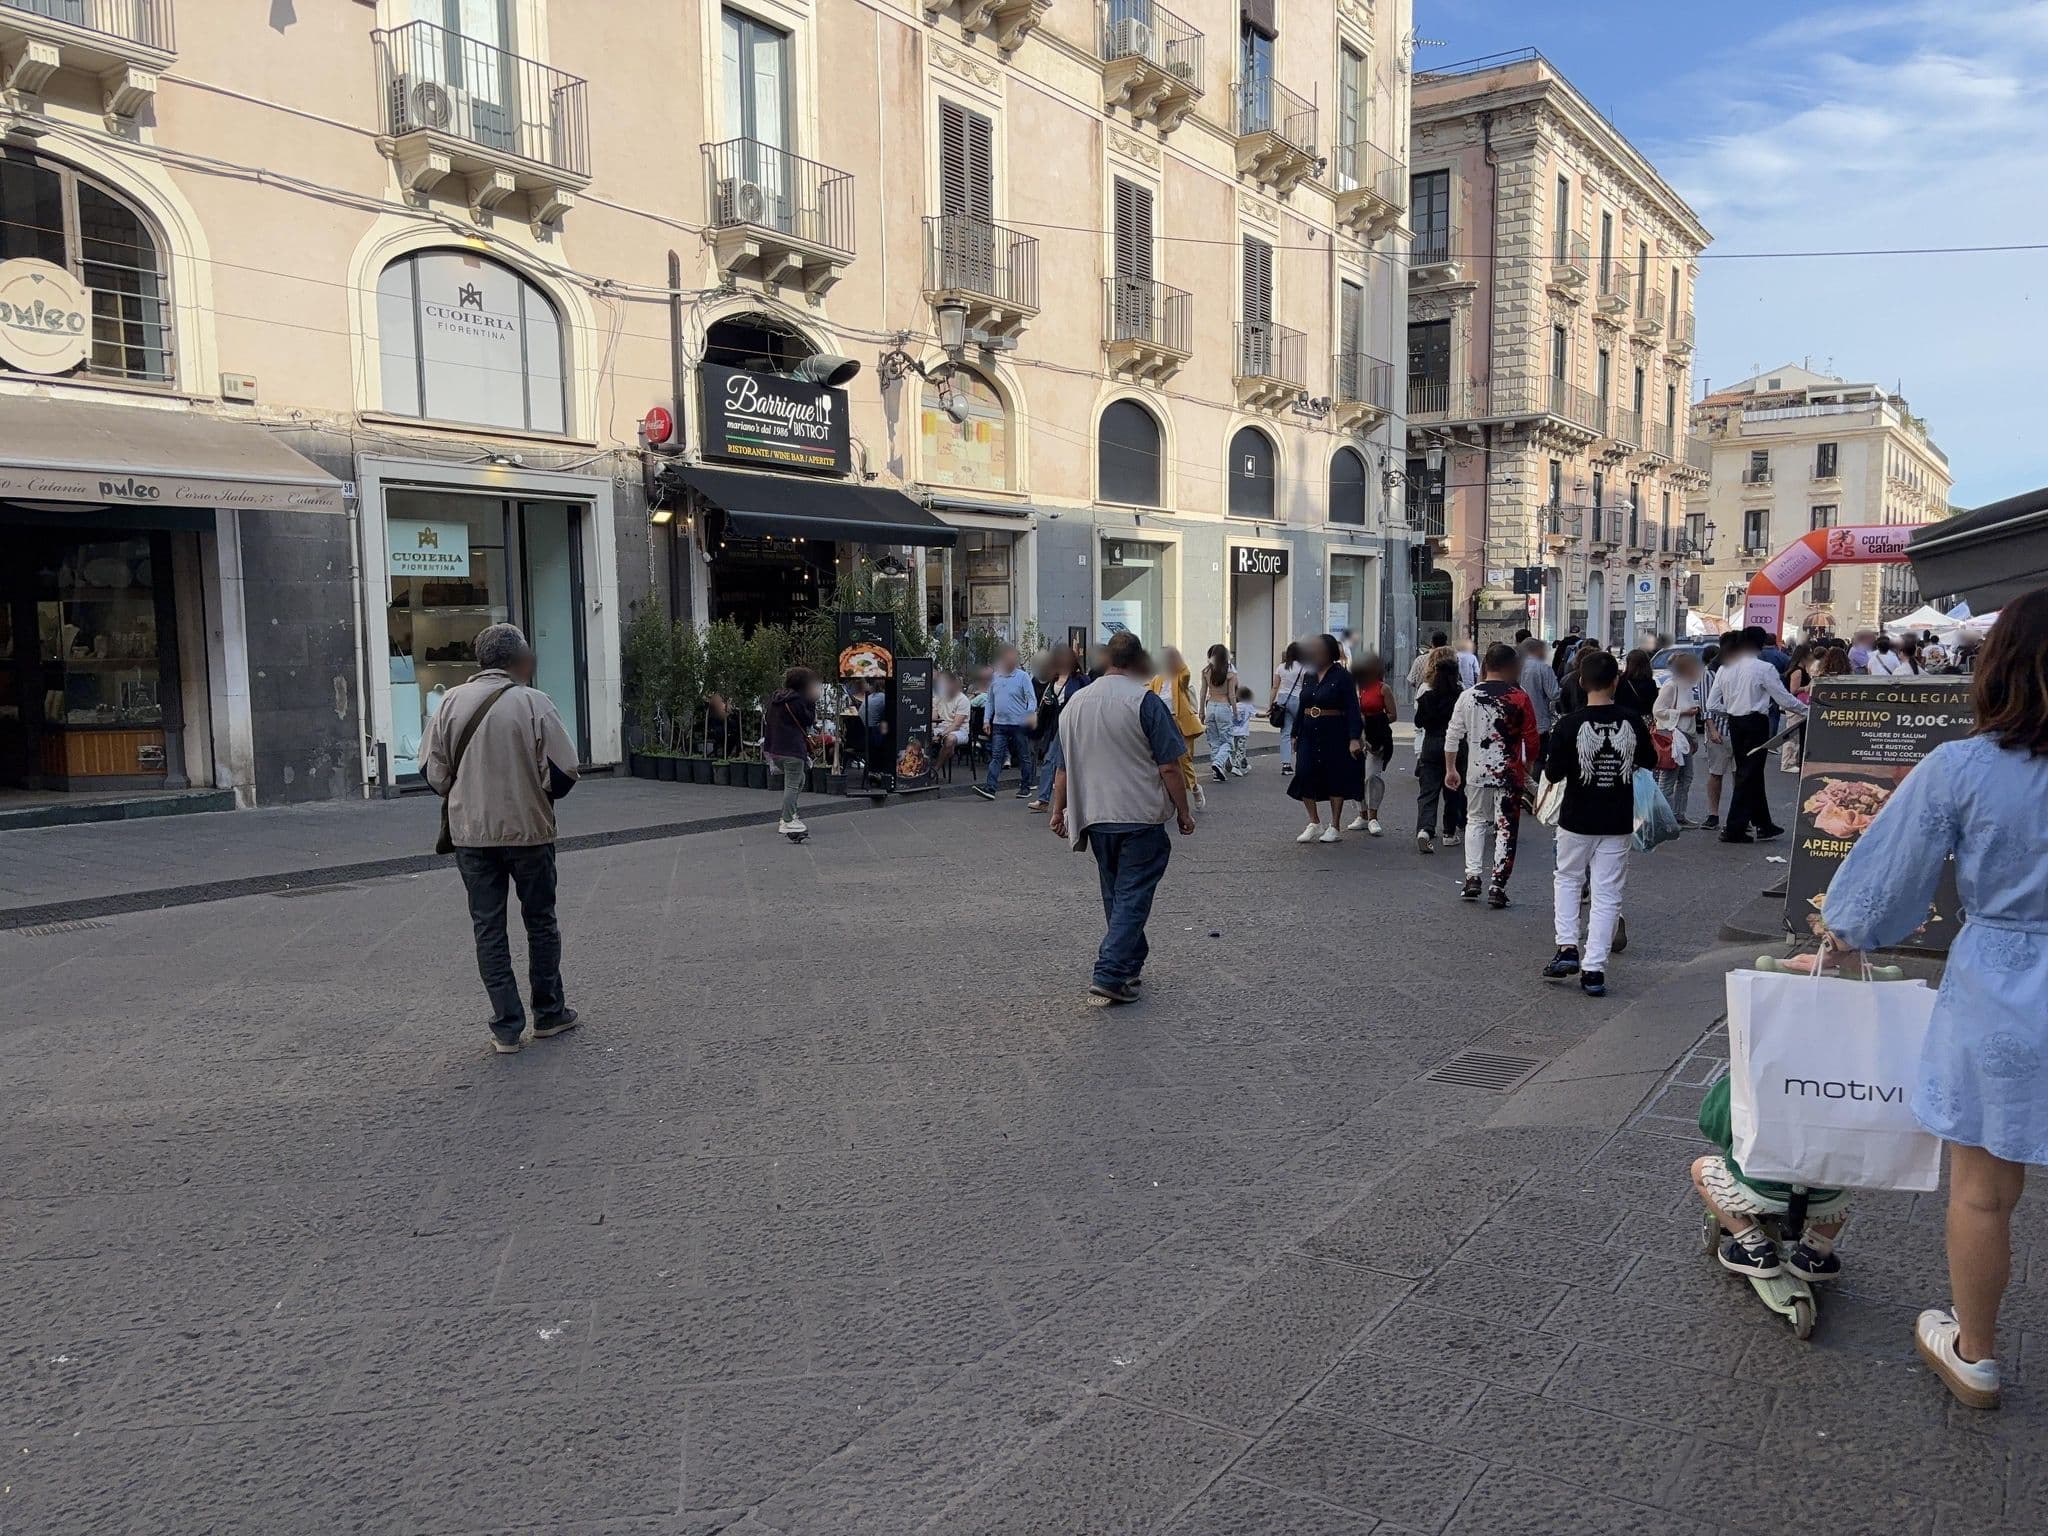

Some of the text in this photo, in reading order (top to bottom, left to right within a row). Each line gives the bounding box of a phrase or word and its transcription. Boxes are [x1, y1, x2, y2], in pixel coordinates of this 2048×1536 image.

[426, 305, 514, 331] CUOIERIA
[438, 322, 505, 341] FIORENTINA
[725, 375, 816, 430] Barrique
[773, 427, 789, 437] 1986
[794, 422, 829, 440] BISTROT
[727, 444, 769, 458] RISTORANTE
[774, 450, 790, 461] WINE
[791, 452, 804, 463] BAR
[1861, 535, 1889, 545] corri
[392, 552, 463, 563] CUOIERIA
[1239, 548, 1281, 574] R-Store
[1820, 710, 1891, 721] APERITIVO
[1896, 714, 1948, 727] 12,00€
[1803, 839, 1857, 852] APERIF
[1810, 850, 1839, 858] (HAPPY
[1785, 1078, 1903, 1103] motivi
